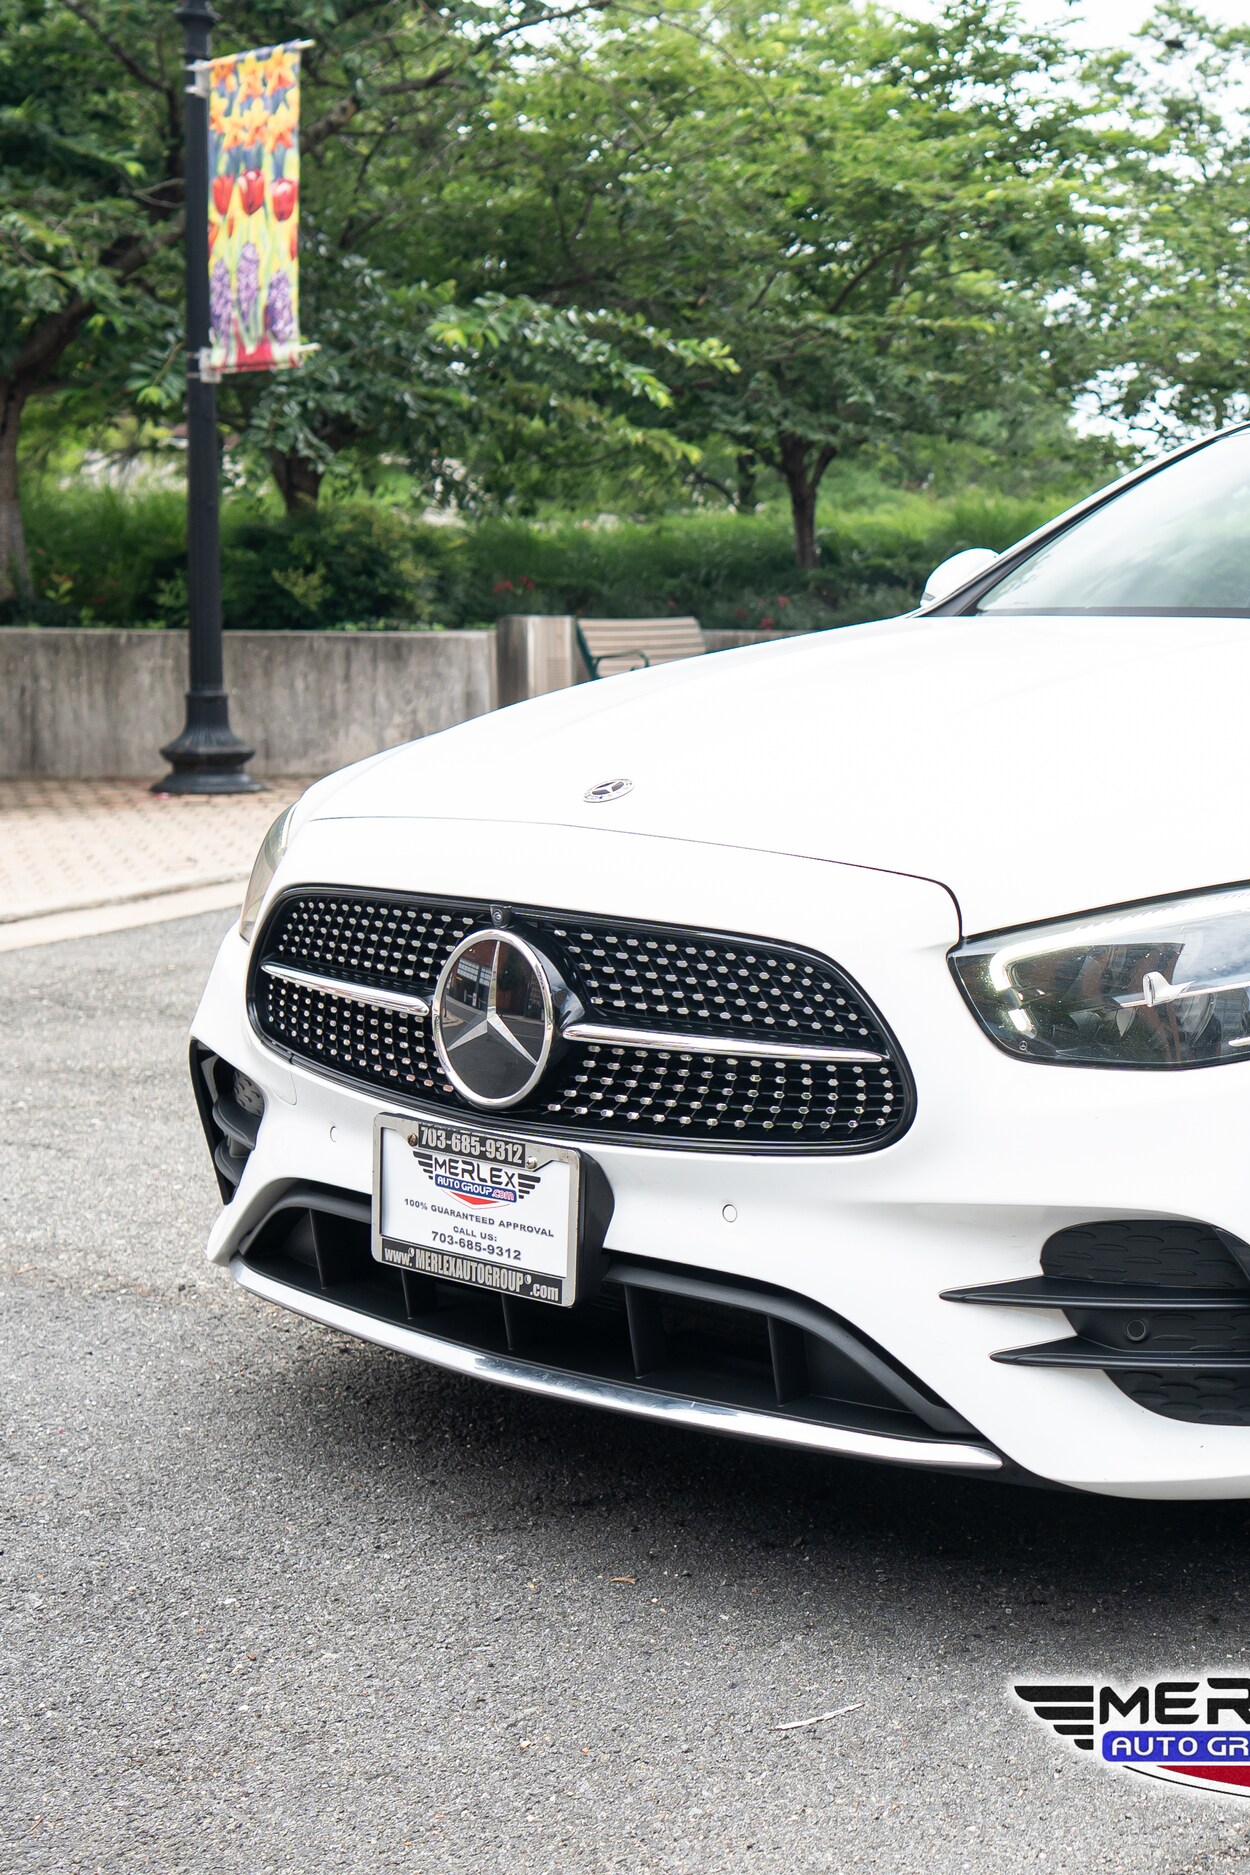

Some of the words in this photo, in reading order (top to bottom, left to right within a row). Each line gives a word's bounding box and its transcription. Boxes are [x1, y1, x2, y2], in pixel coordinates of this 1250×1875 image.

[421, 1125, 523, 1164] 703-685-9312
[434, 1156, 516, 1189] MERLEX
[437, 1176, 460, 1190] AUTO
[404, 1198, 428, 1211] 100%
[430, 1204, 495, 1226] GUARANTEED
[498, 1219, 554, 1238] APPROVAL
[453, 1225, 477, 1238] CALL
[480, 1231, 497, 1242] US:
[431, 1230, 521, 1261] 703-685-9312
